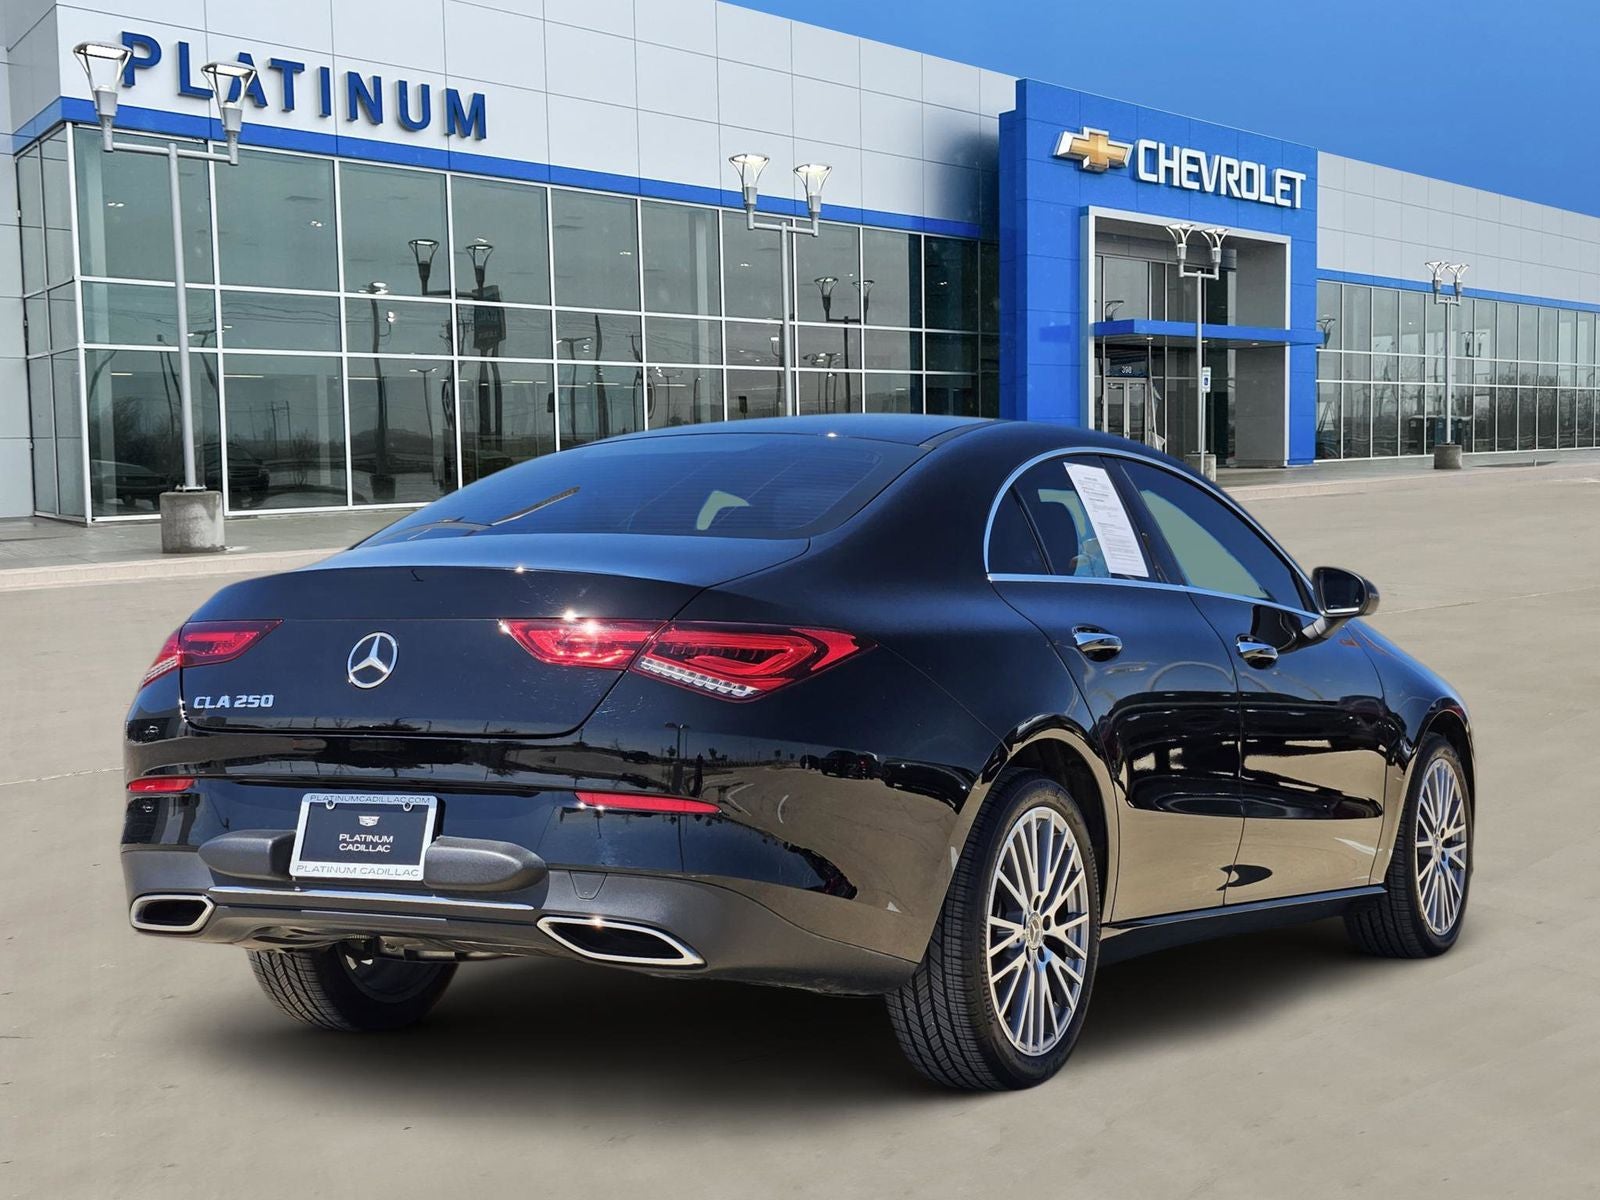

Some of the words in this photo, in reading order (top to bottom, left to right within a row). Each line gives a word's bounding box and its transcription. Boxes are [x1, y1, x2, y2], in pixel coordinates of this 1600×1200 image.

[120, 31, 488, 141] PLATINUM
[1135, 139, 1307, 209] CHEVROLET
[193, 694, 231, 709] CLA
[233, 694, 275, 708] 250
[339, 834, 394, 843] PLATINUM
[339, 844, 391, 853] CADILLAC
[296, 864, 357, 875] PLATINUM
[360, 867, 419, 877] CADILLAC
